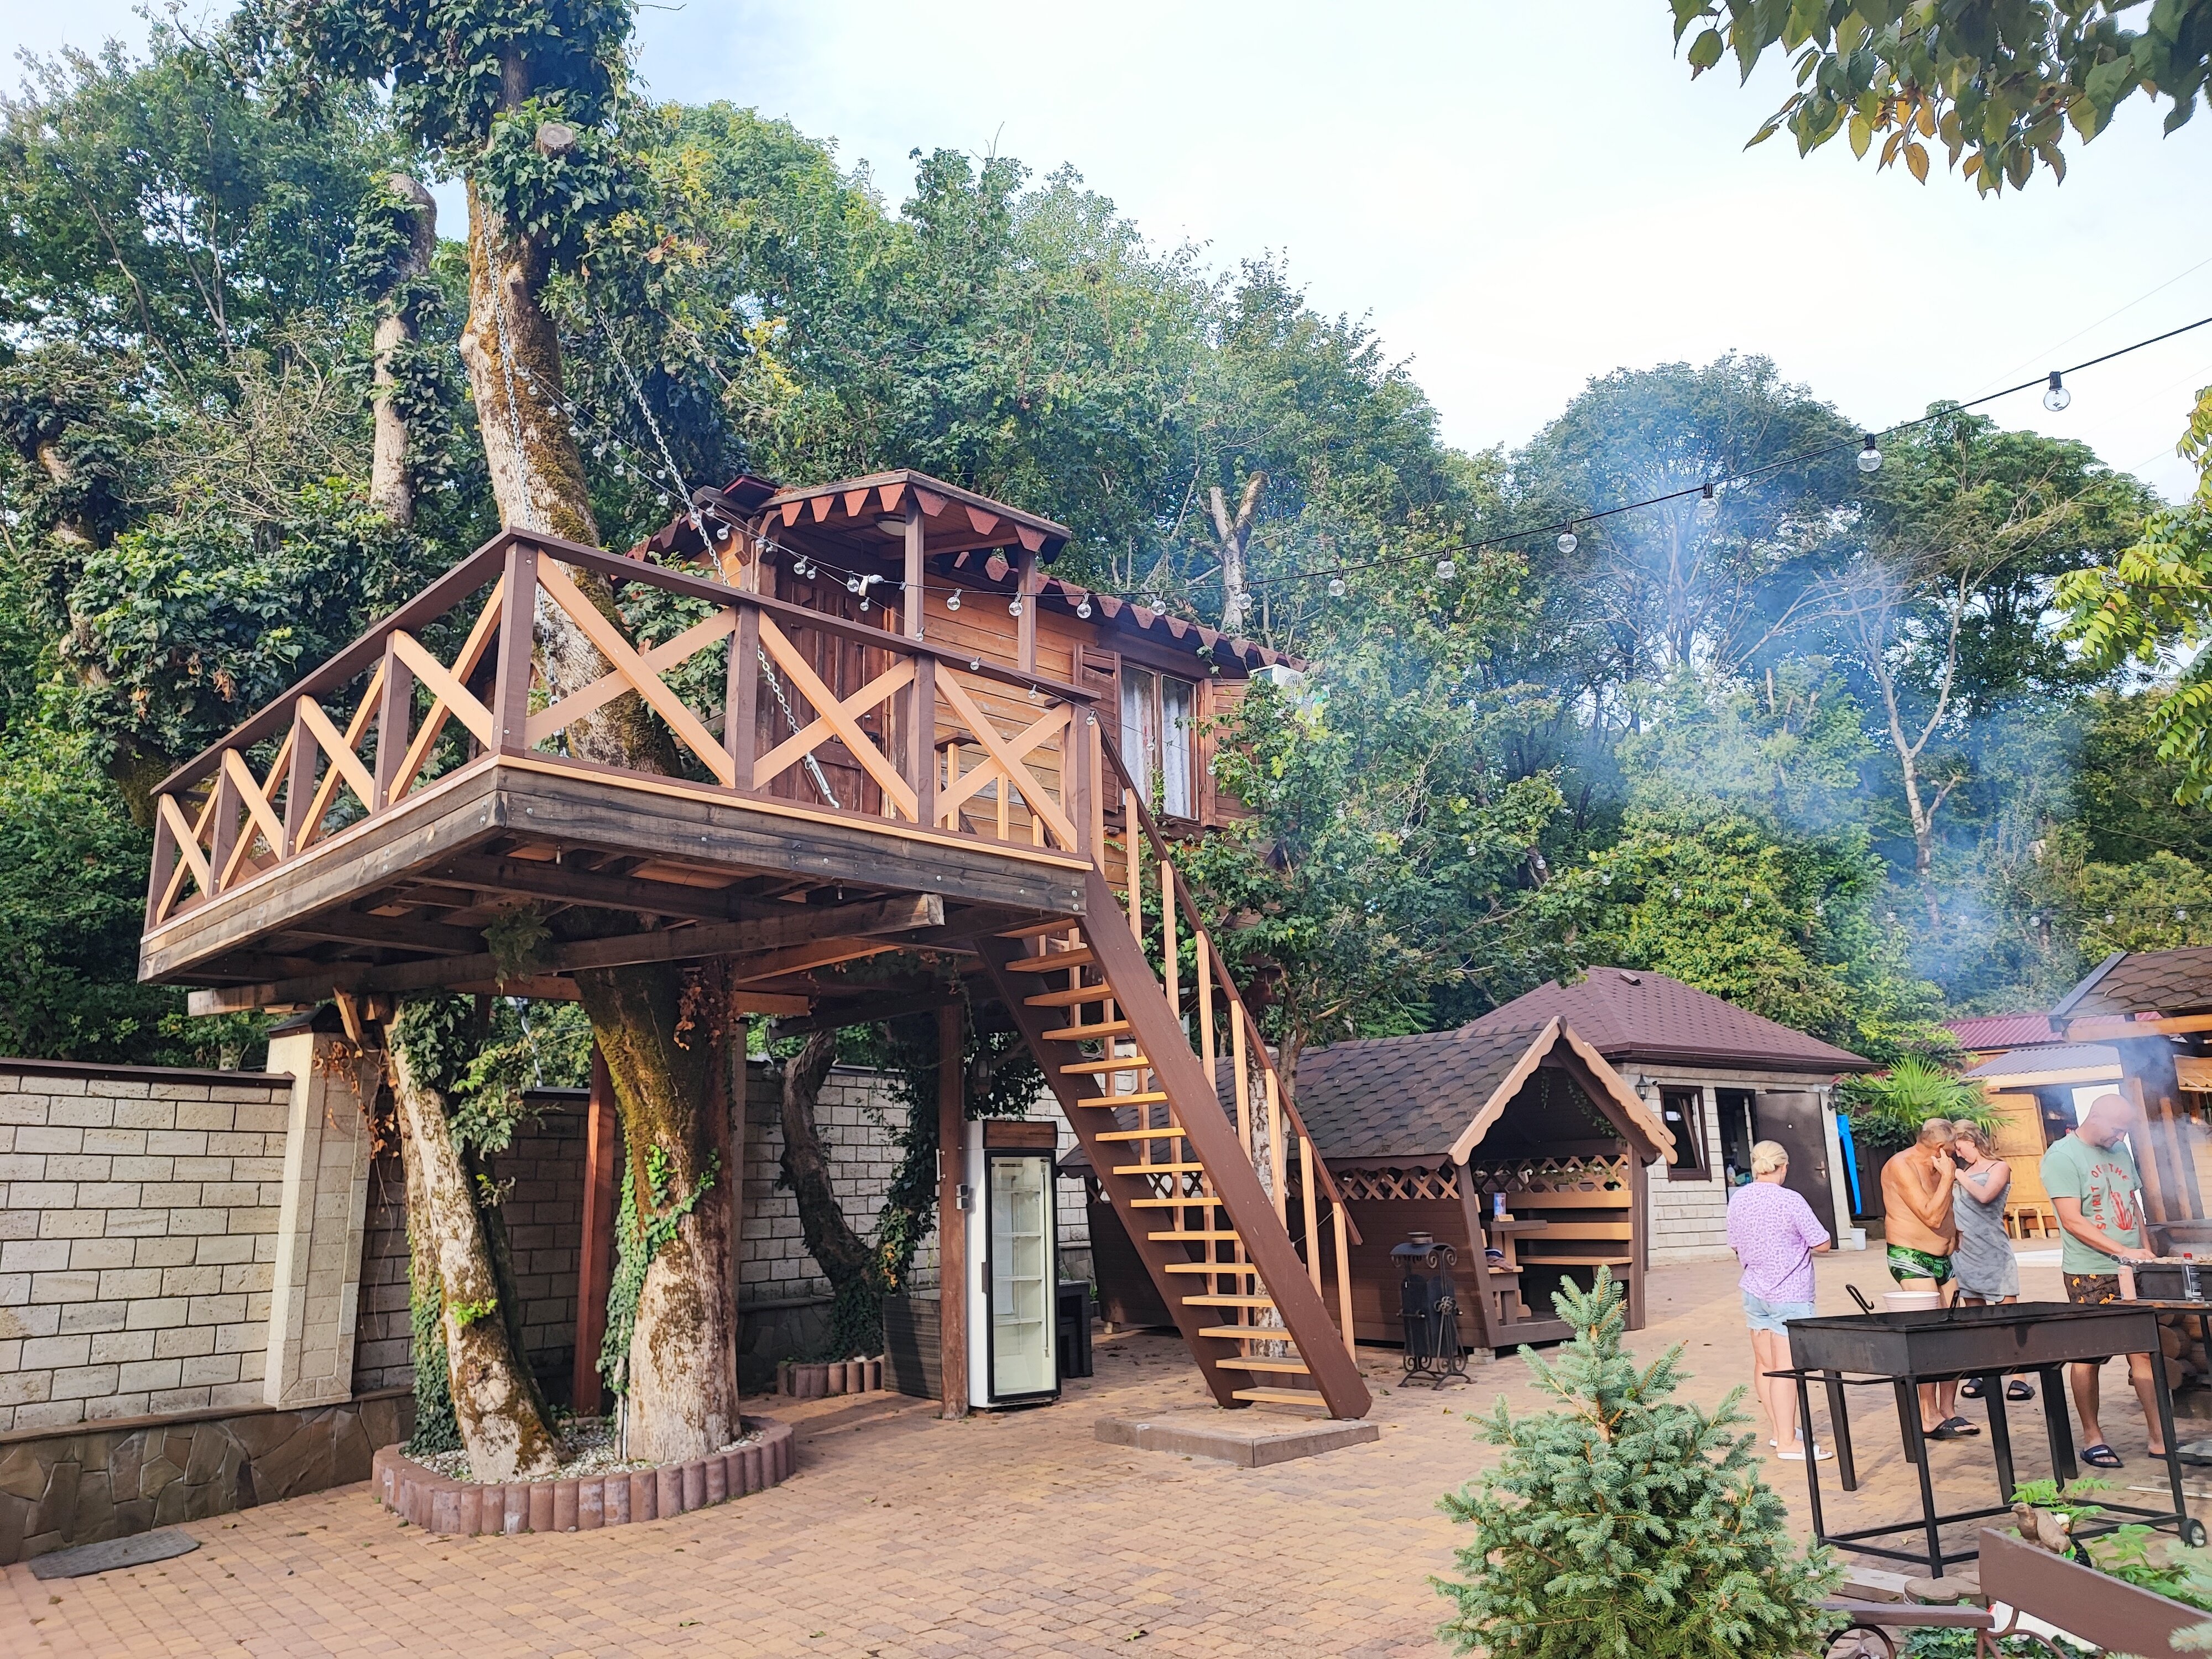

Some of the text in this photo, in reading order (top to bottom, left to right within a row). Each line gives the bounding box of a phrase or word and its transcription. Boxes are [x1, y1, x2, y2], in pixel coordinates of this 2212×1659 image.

[2091, 1163, 2128, 1229] SPIRIT OF THE
